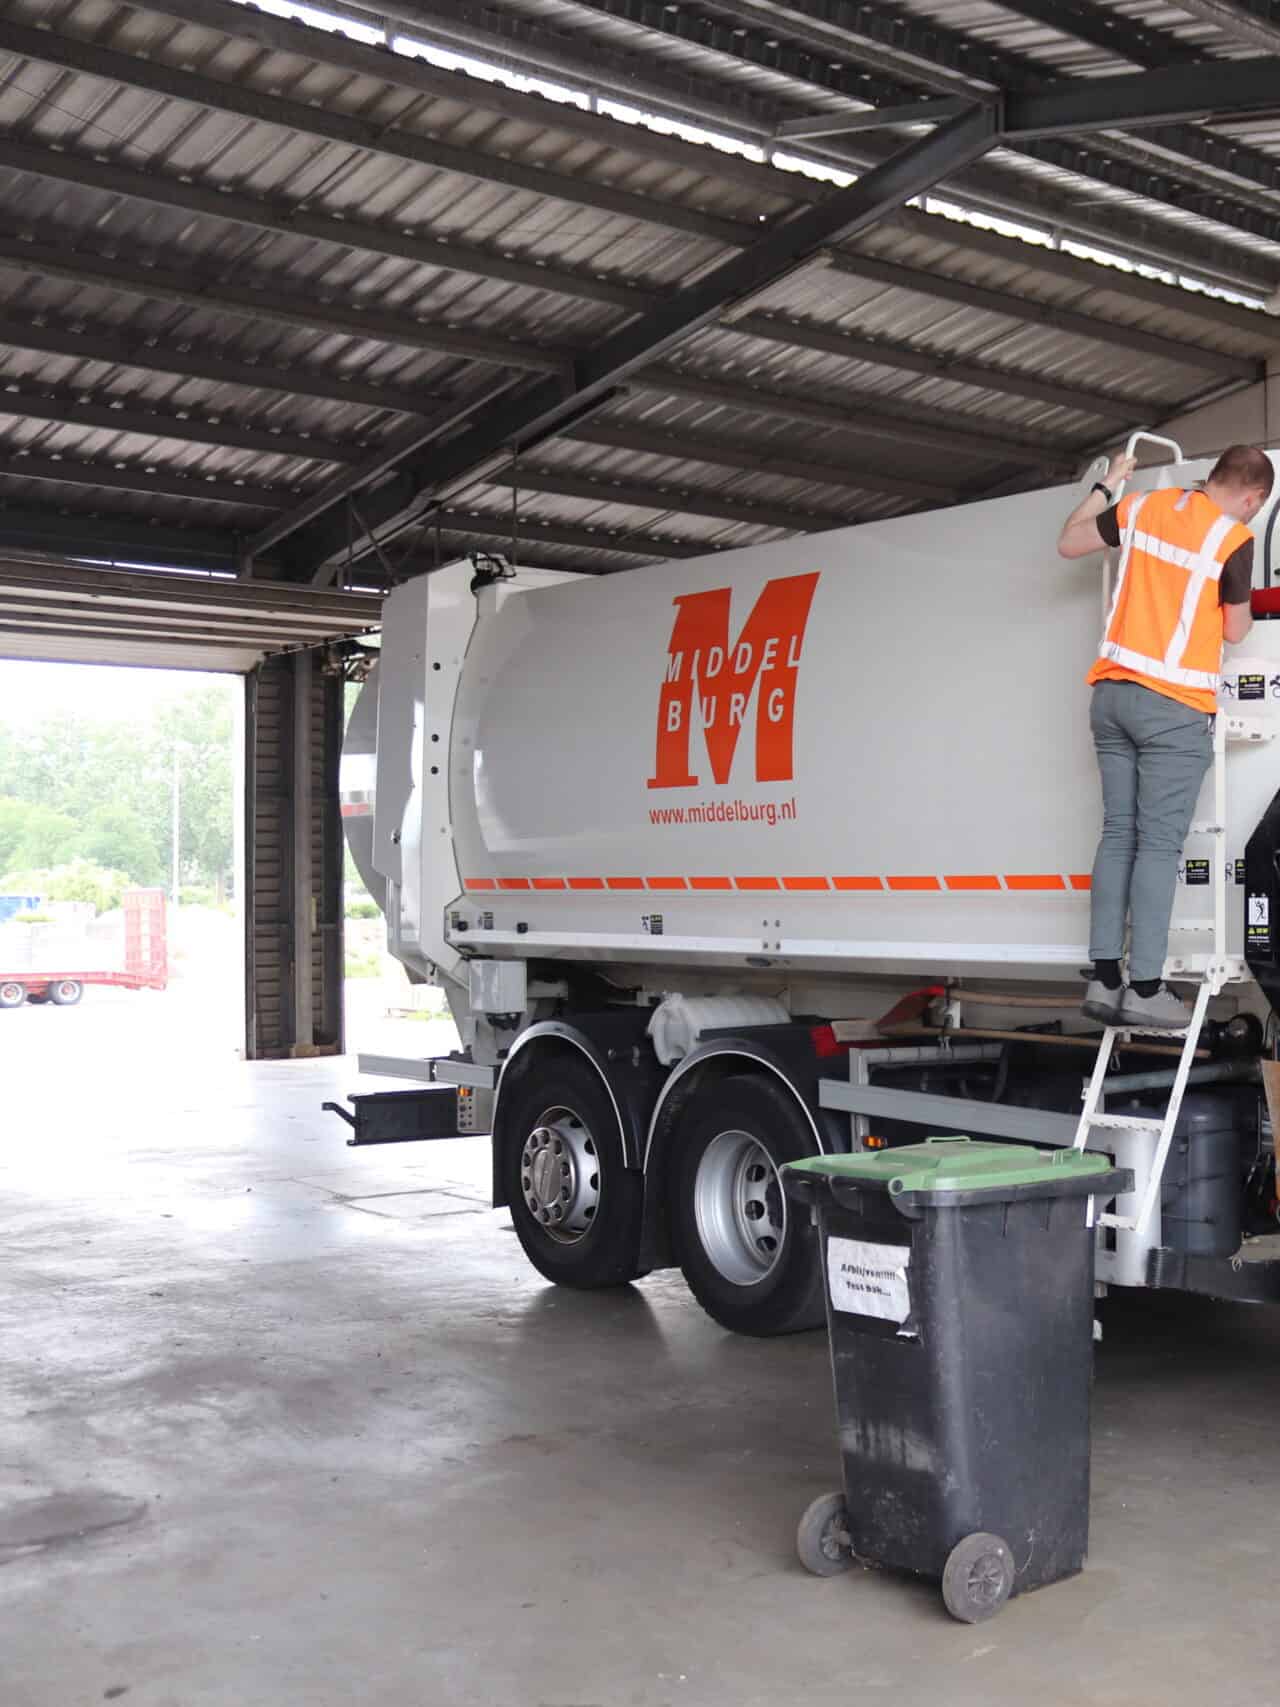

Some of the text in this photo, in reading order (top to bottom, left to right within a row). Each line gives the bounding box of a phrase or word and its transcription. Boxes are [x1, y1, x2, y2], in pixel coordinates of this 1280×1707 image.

[664, 635, 800, 683] MIDDEL
[666, 688, 784, 732] BURG
[649, 798, 797, 826] www.middelburg.nl
